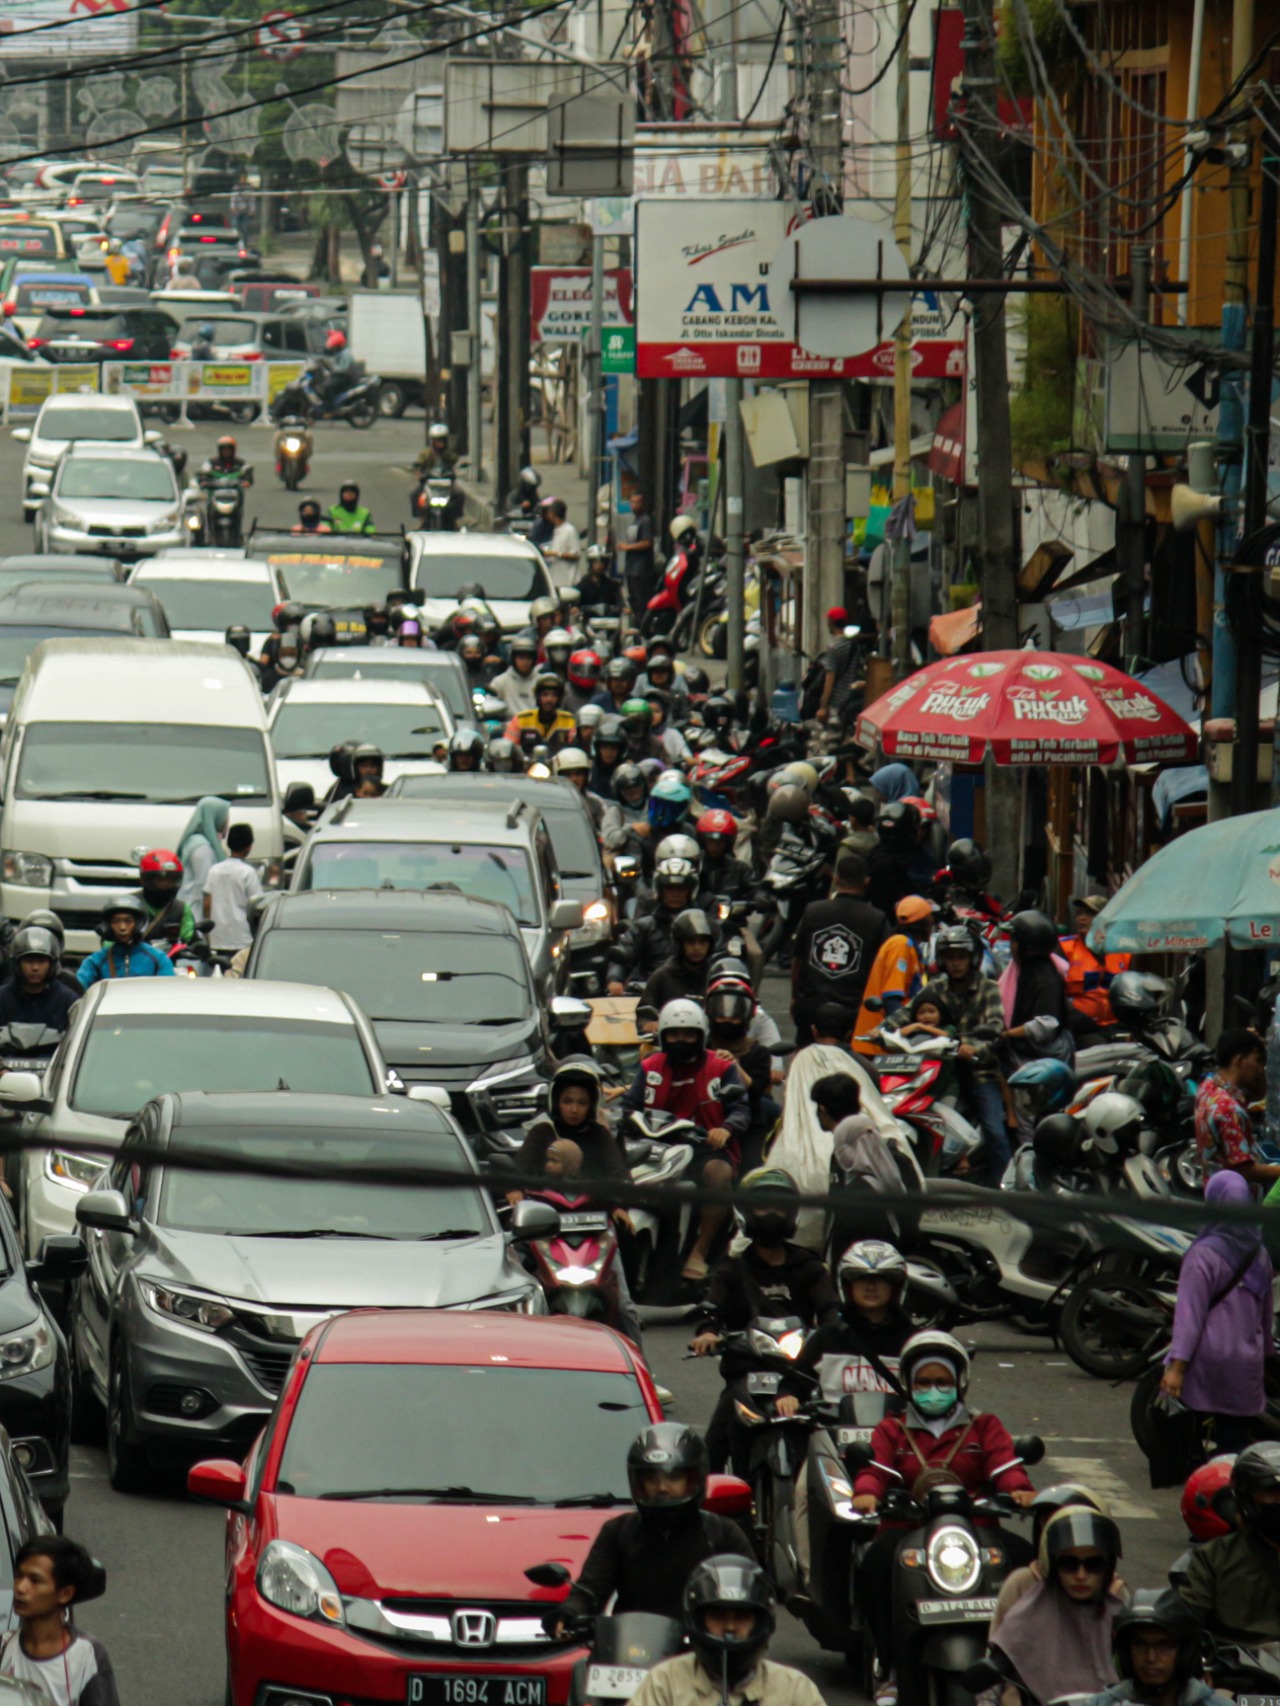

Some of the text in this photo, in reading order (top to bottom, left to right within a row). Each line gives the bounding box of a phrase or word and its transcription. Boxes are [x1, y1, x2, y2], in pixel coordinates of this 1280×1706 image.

[718, 229, 755, 249] Sunda
[552, 289, 617, 301] ELEGN
[682, 316, 721, 325] CABANG
[724, 316, 757, 325] KEBON
[760, 316, 777, 325] KA
[1006, 686, 1036, 699] Teh
[1011, 739, 1037, 750] Rasa
[1060, 738, 1099, 750] Terbaik
[1249, 921, 1271, 939] Le
[592, 1669, 643, 1682] D 2855
[412, 1678, 541, 1705] D 1694 ACM
